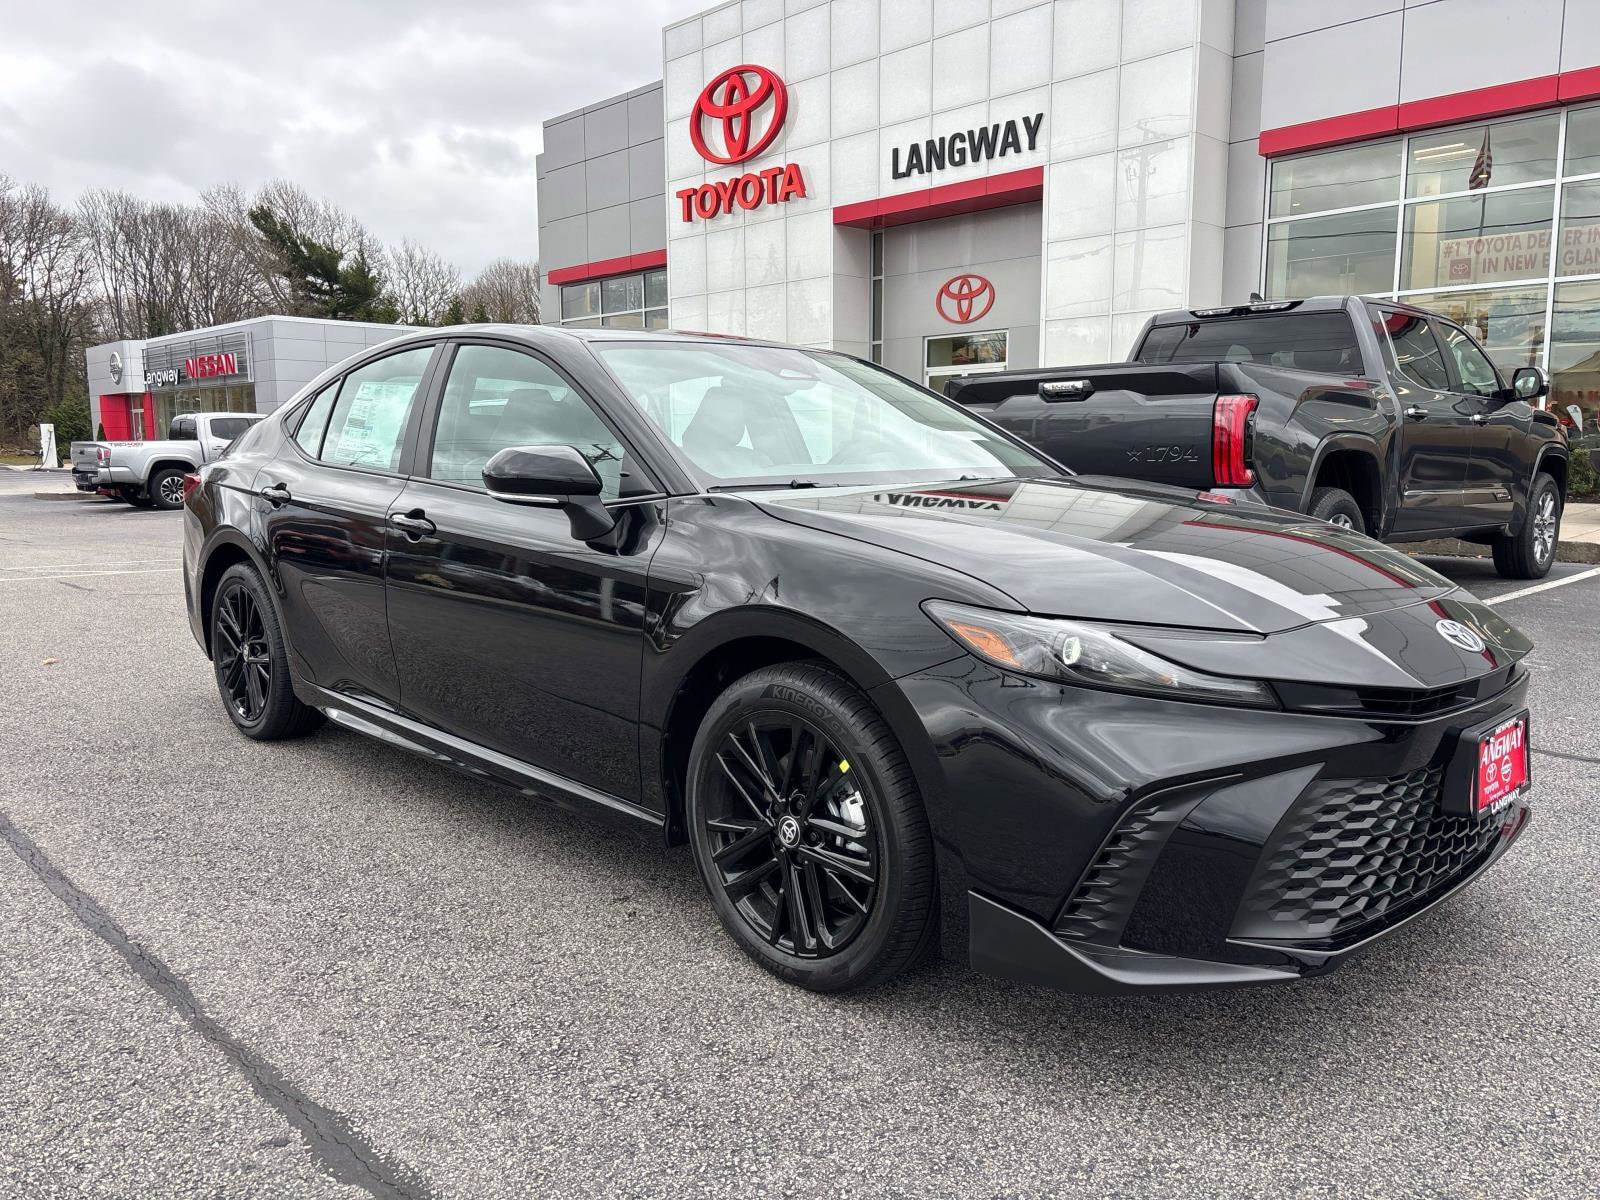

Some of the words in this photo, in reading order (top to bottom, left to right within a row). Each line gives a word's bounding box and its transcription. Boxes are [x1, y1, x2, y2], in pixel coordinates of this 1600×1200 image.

[892, 113, 1043, 179] LANGWAY
[676, 163, 806, 222] TOYOTA
[1443, 240, 1460, 258] #1
[1466, 235, 1521, 255] TOYOTA
[1527, 229, 1582, 250] DEAER
[1482, 257, 1499, 273] IN
[1504, 254, 1537, 271] NEW
[143, 368, 179, 386] Langway
[185, 353, 237, 379] NISSAN
[1146, 446, 1199, 462] 1794
[772, 685, 834, 719] KINERGY
[1480, 727, 1523, 768] ANGWAY
[1491, 788, 1520, 814] LANGWAY
